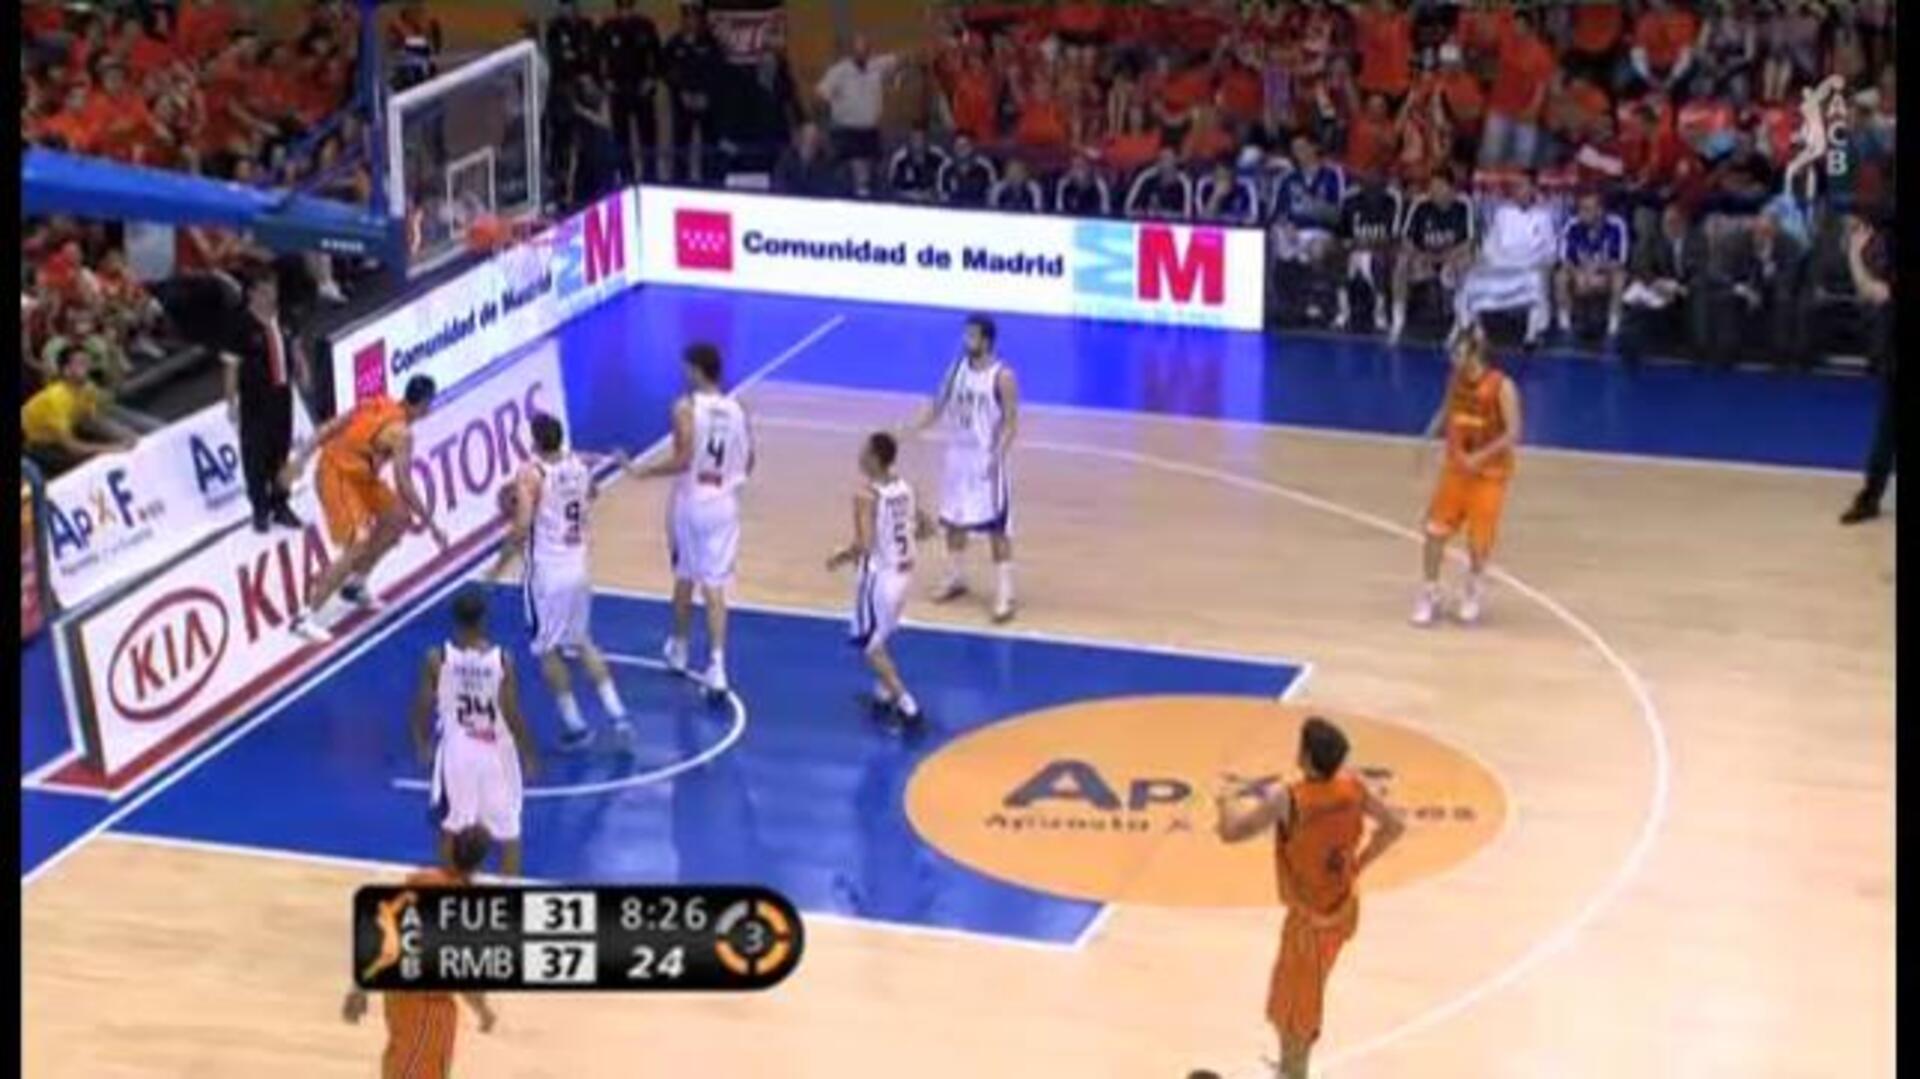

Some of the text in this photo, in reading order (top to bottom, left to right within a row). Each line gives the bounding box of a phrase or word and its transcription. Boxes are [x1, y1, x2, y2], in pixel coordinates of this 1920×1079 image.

[742, 230, 907, 268] Comunidad
[916, 242, 952, 270] de
[962, 245, 1065, 280] Madrid
[390, 309, 476, 376] Comunidad
[479, 299, 498, 330] de
[236, 523, 333, 644] KIA
[129, 607, 213, 701] KIA
[457, 693, 496, 726] 24
